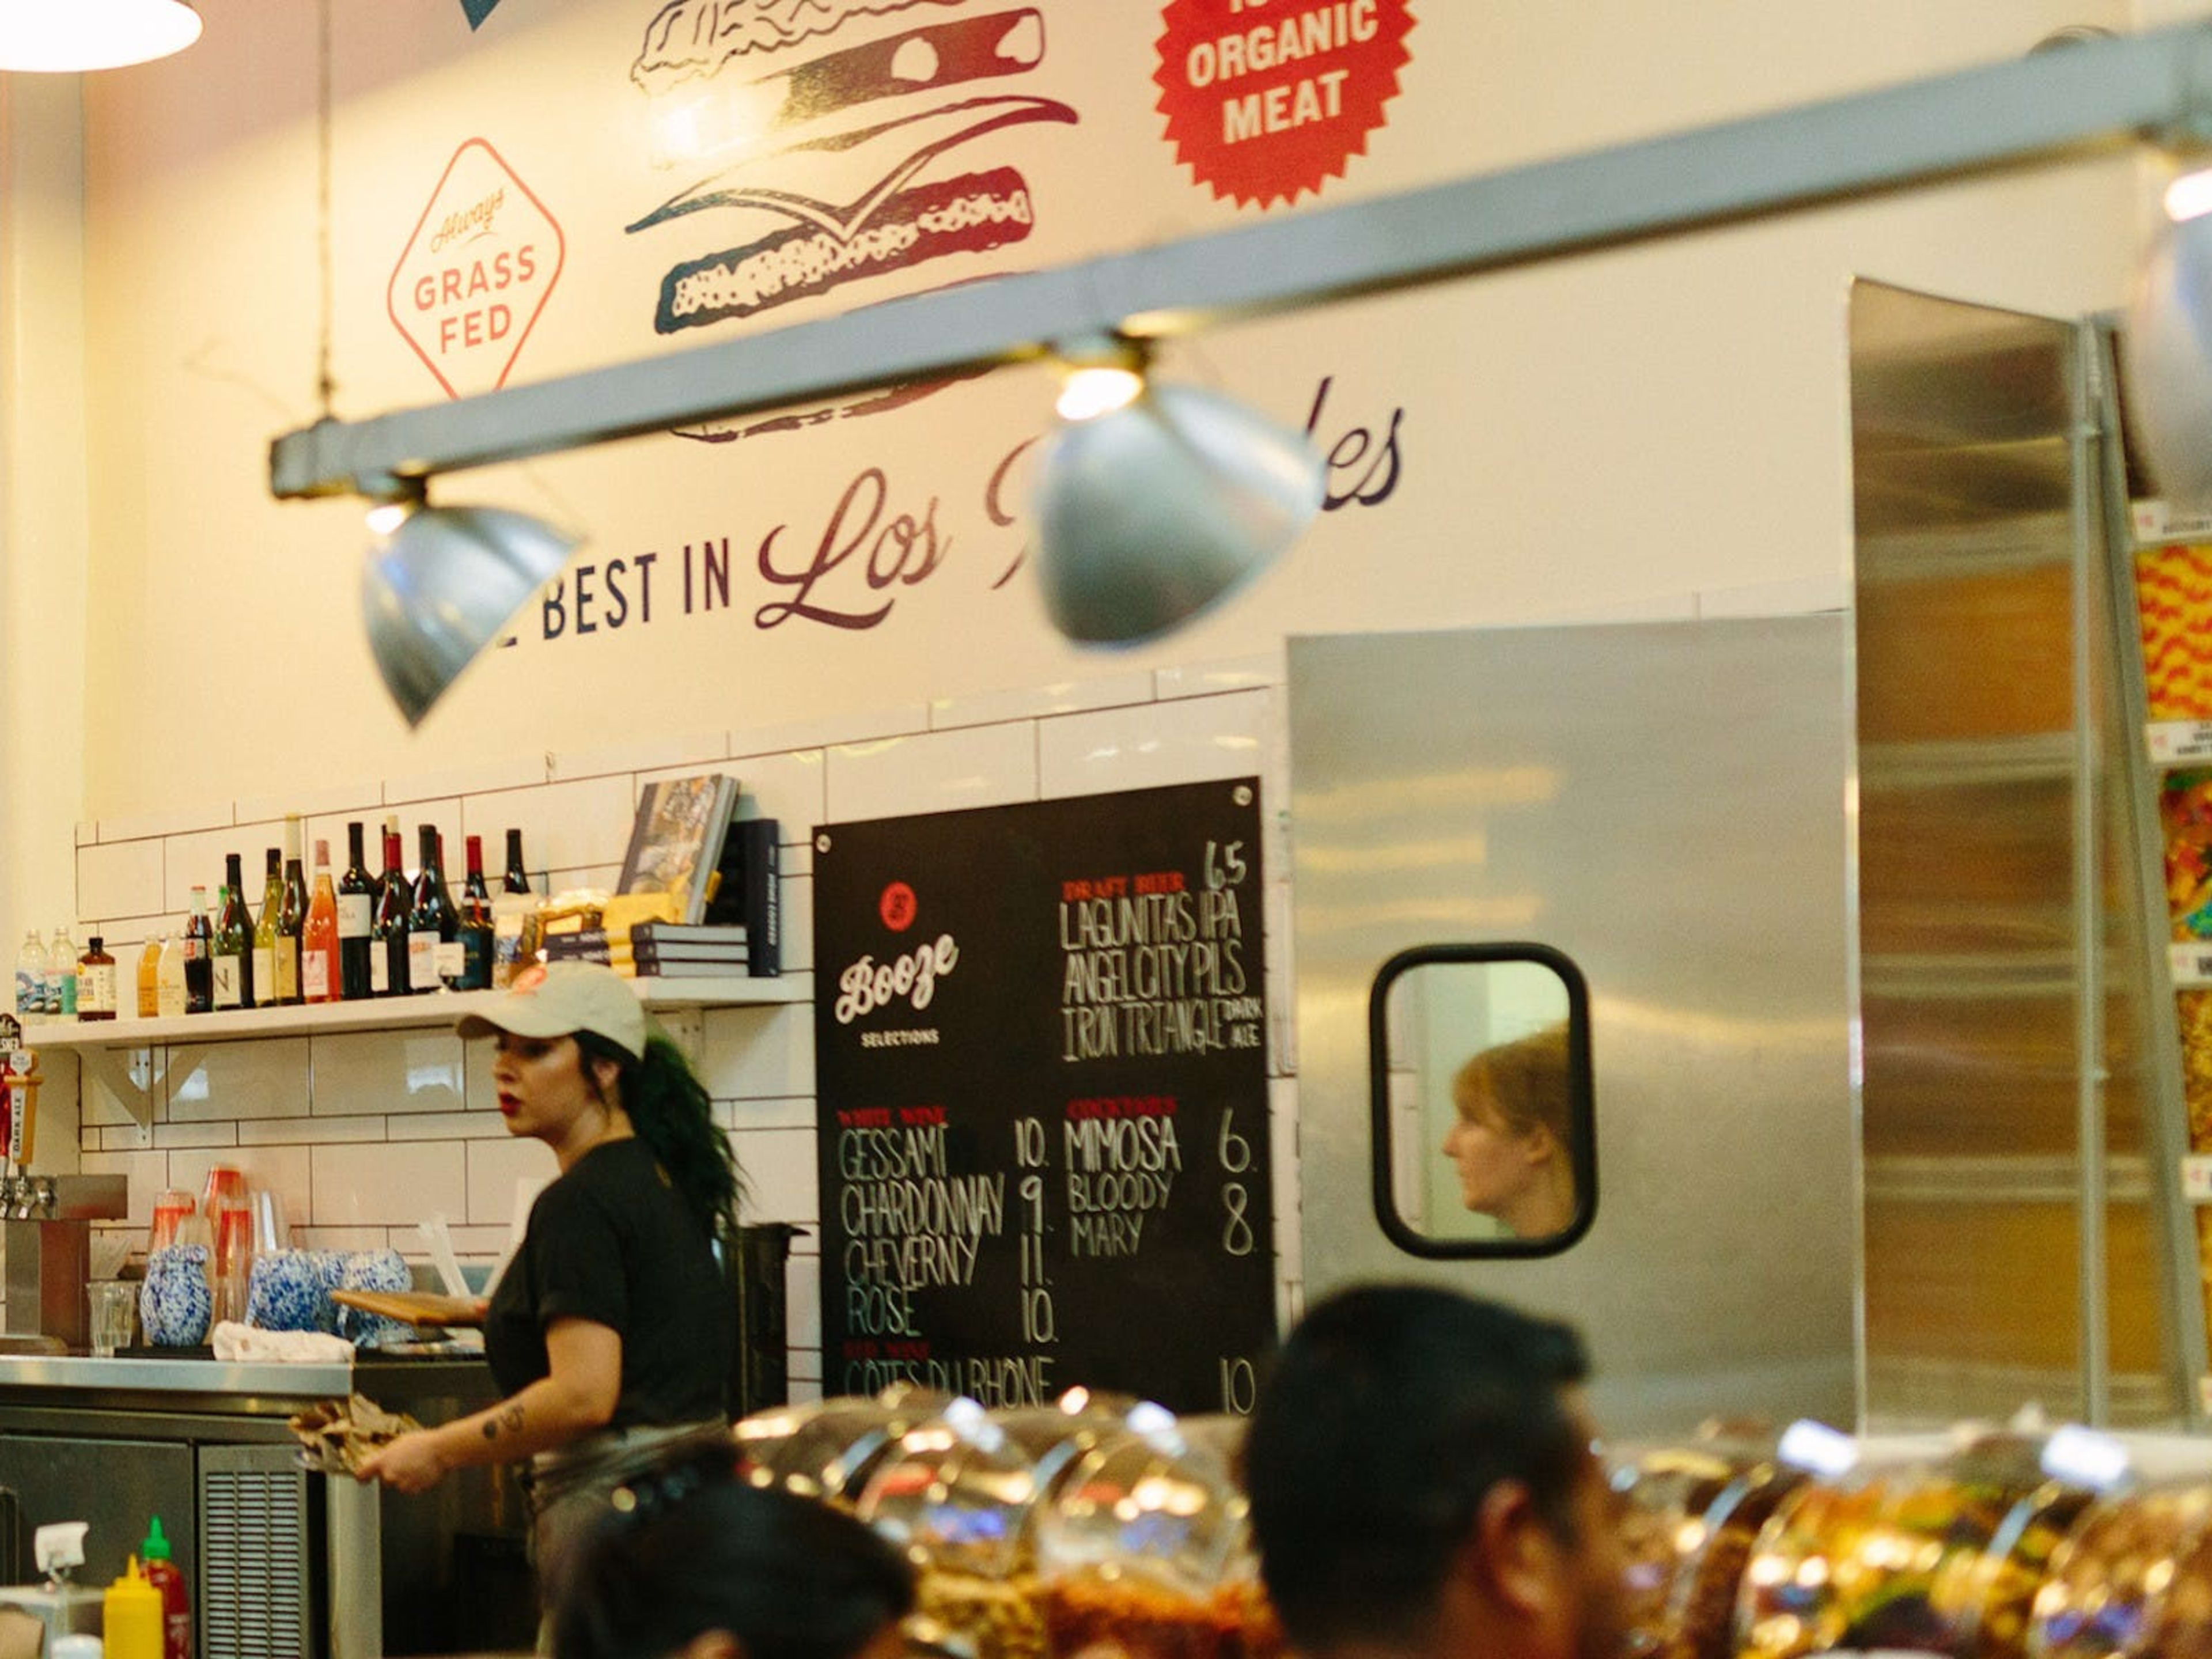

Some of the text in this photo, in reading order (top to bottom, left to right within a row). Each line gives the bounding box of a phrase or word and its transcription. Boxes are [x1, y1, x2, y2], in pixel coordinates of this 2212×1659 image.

[1187, 0, 1379, 88] ORGANIC
[1223, 70, 1349, 144] MEAT
[431, 188, 504, 253] Always
[414, 246, 535, 310] GRASS
[441, 304, 511, 354] FED
[543, 552, 657, 639] BEST
[684, 538, 729, 614] IN
[755, 467, 952, 630] Los
[1059, 889, 1242, 950] LAGUNITAS IPA
[835, 934, 960, 1024] Booze
[1063, 938, 1247, 1004] ANGEL CITY PILS
[861, 1029, 940, 1048] SELECTIONS
[1060, 998, 1227, 1062] IRON TRIANGLE
[1064, 1115, 1182, 1172] MIMOSA
[841, 1173, 1005, 1237] CHARDONNAY
[1069, 1171, 1174, 1213] BLOODY
[845, 1235, 979, 1286] CHEVERNY
[1071, 1212, 1143, 1257] MARY
[848, 1284, 922, 1337] ROSE
